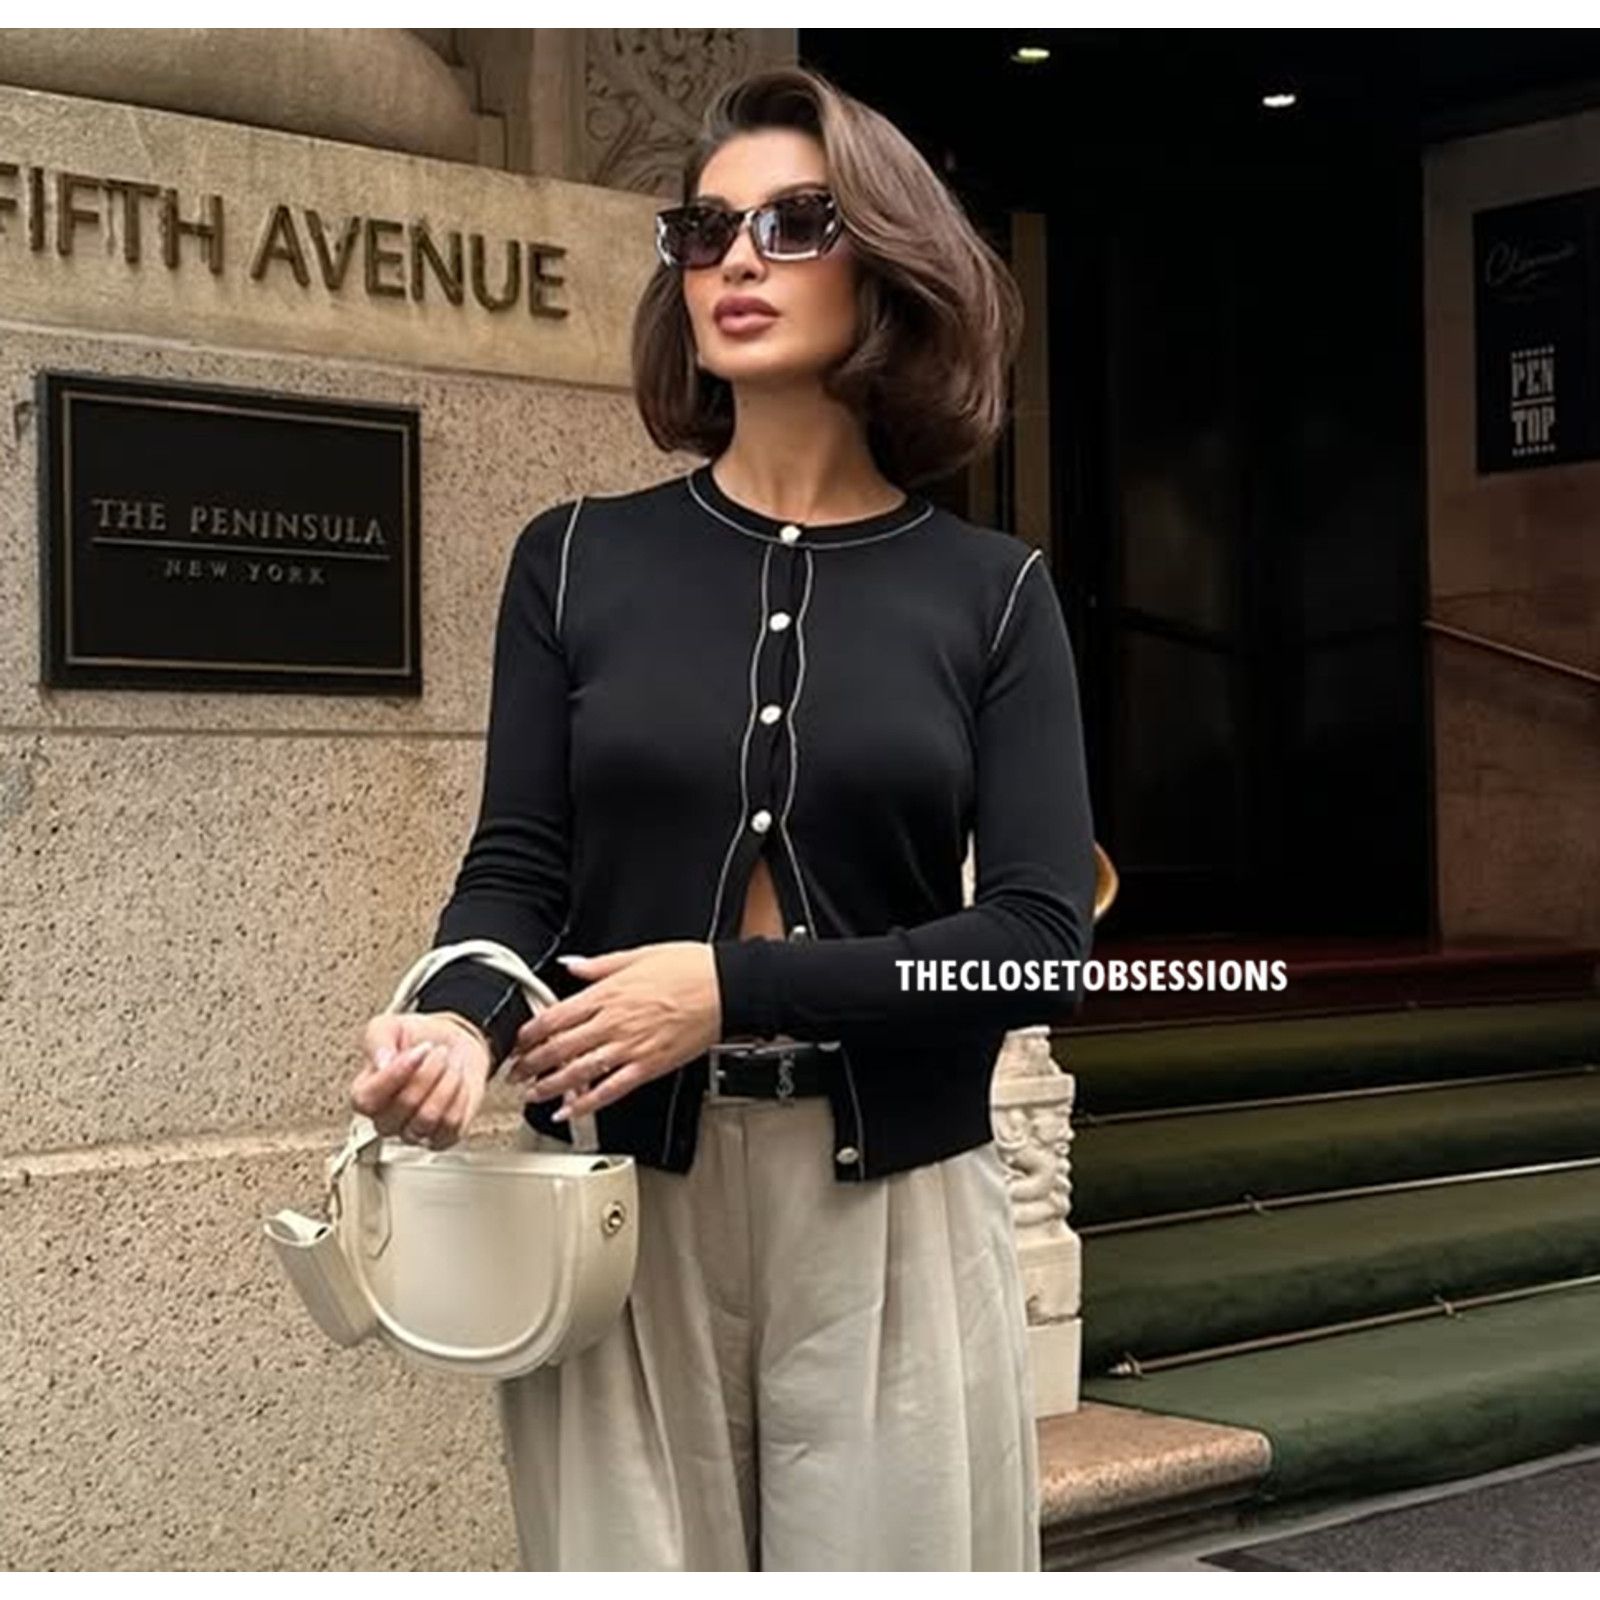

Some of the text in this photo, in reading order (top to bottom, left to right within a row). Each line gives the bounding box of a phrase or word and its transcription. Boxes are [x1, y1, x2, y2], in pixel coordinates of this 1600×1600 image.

[250, 203, 569, 320] AVENUE
[1511, 357, 1555, 399] PEN
[1511, 405, 1556, 446] TOP
[92, 498, 385, 546] THE PENINSULA
[162, 559, 326, 585] NEW YORK
